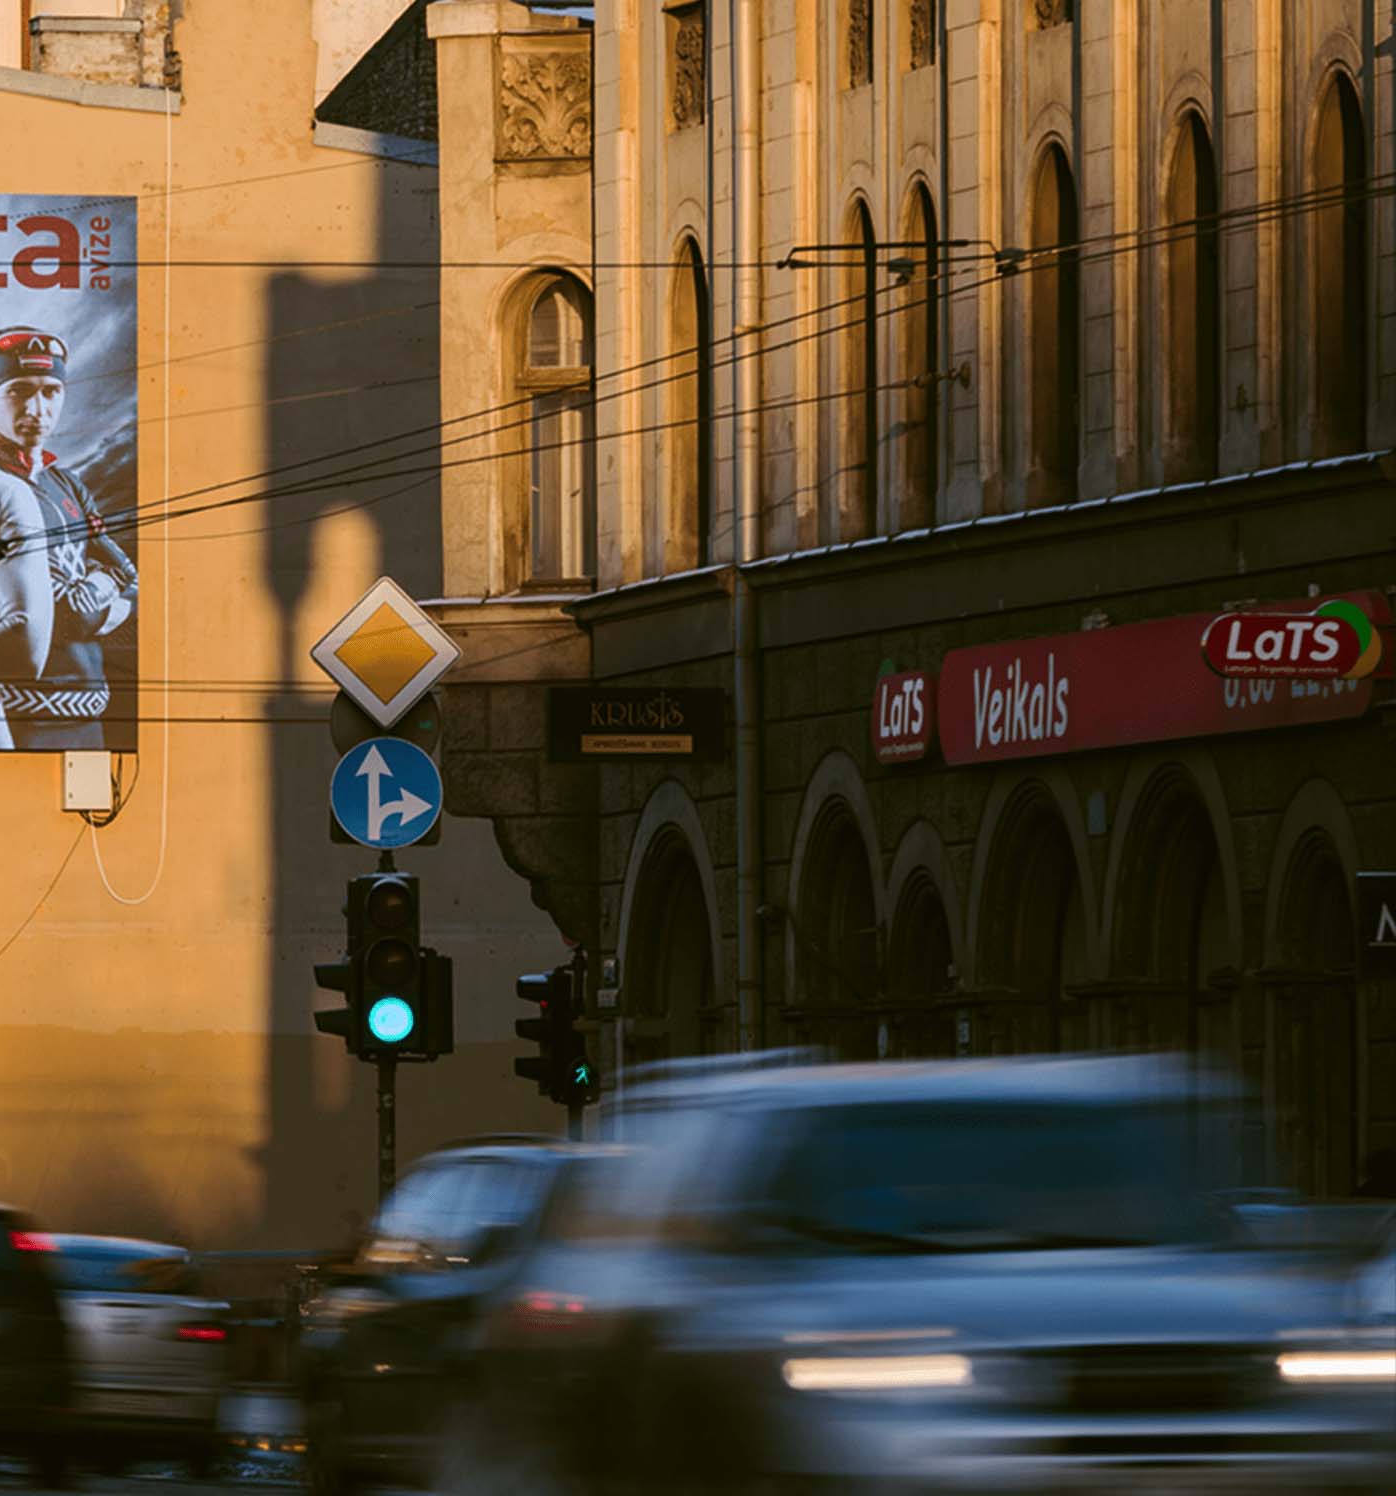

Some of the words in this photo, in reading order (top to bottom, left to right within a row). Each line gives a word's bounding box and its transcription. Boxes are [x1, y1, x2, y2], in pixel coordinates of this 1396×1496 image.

[83, 216, 111, 291] avīze
[1226, 620, 1340, 662] LaTS
[879, 677, 925, 738] LaTS
[973, 653, 1069, 750] Veikals
